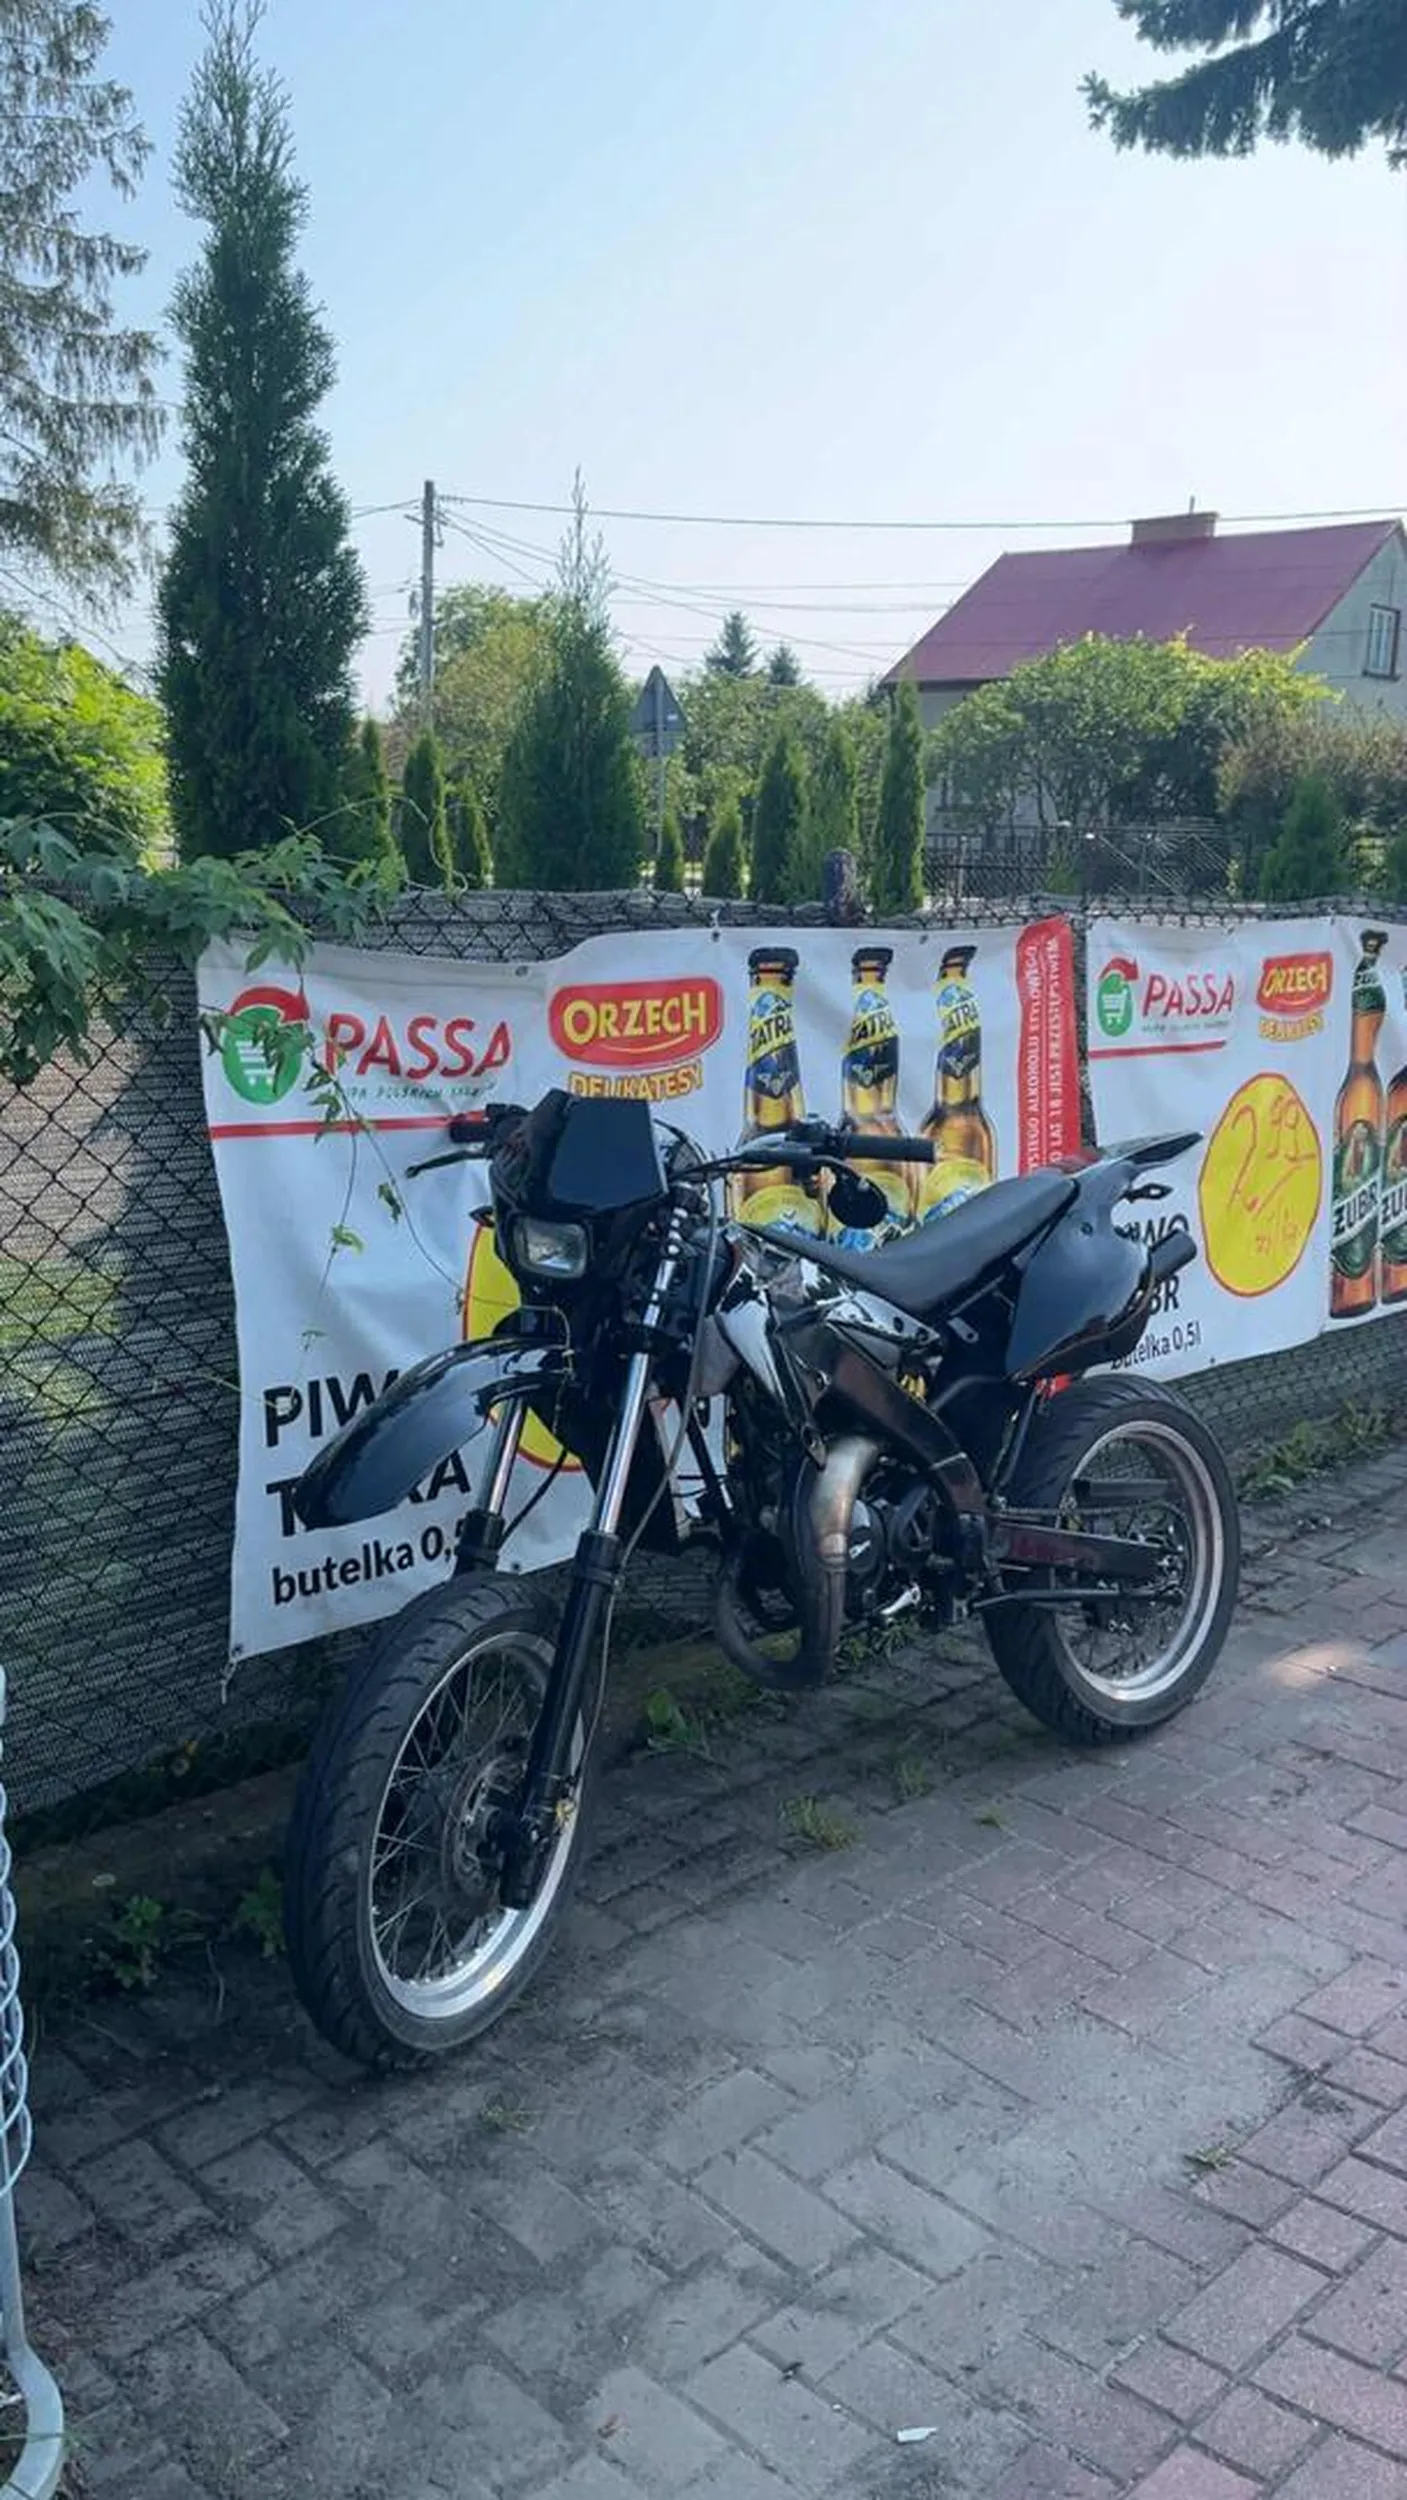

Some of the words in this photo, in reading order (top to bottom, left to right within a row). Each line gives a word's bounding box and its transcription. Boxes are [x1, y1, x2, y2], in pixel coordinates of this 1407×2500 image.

[563, 991, 706, 1045] ORZECH
[1142, 972, 1235, 1018] PASSA
[325, 1012, 511, 1079] PASSA
[1027, 1036, 1040, 1112] ALKOHOLU
[1148, 1274, 1180, 1315] BR
[264, 1368, 399, 1448] PIW
[272, 1540, 415, 1606] butelka
[421, 1518, 464, 1564] 0,
